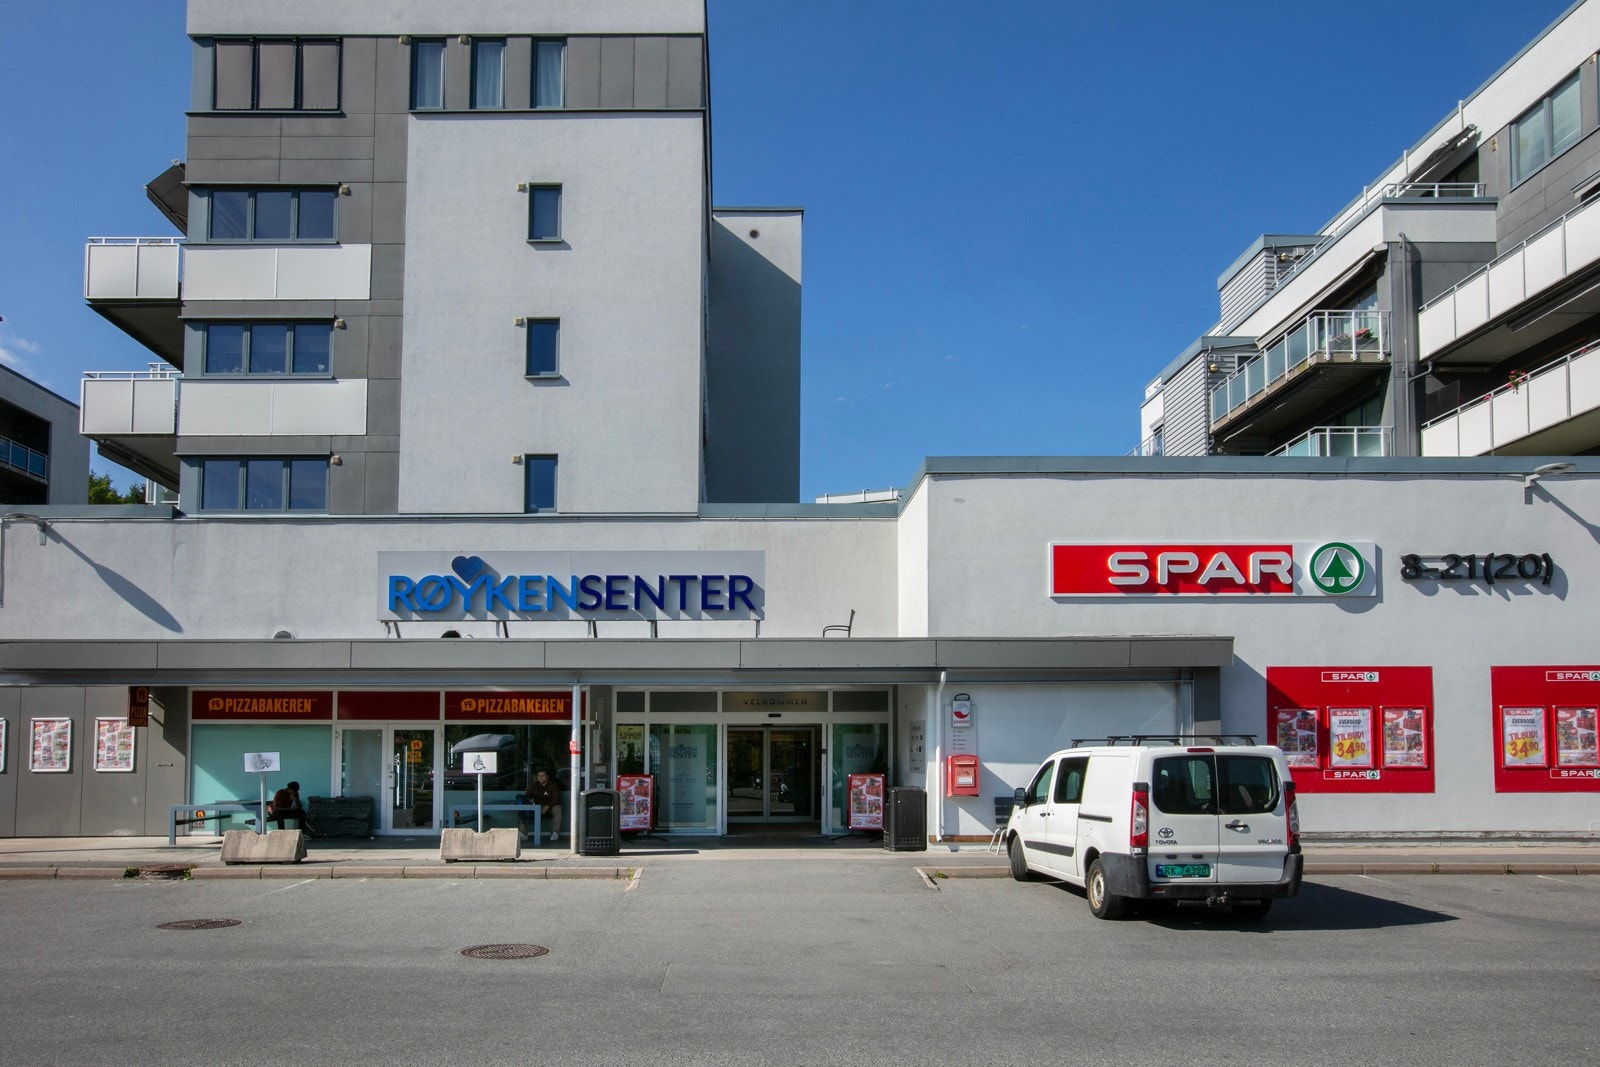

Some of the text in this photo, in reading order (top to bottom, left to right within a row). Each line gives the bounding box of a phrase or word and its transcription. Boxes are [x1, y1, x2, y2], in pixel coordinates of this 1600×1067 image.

[1108, 551, 1293, 585] SPAR
[388, 574, 756, 612] RØYKENSENTER
[225, 698, 312, 713] PIZZABAKEREN
[478, 698, 564, 713] PIZZABAKEREN
[743, 698, 808, 706] VELKOMMEN
[1336, 730, 1365, 741] TILBUD!
[1509, 730, 1538, 741] TILBUD!
[1164, 865, 1176, 874] RK
